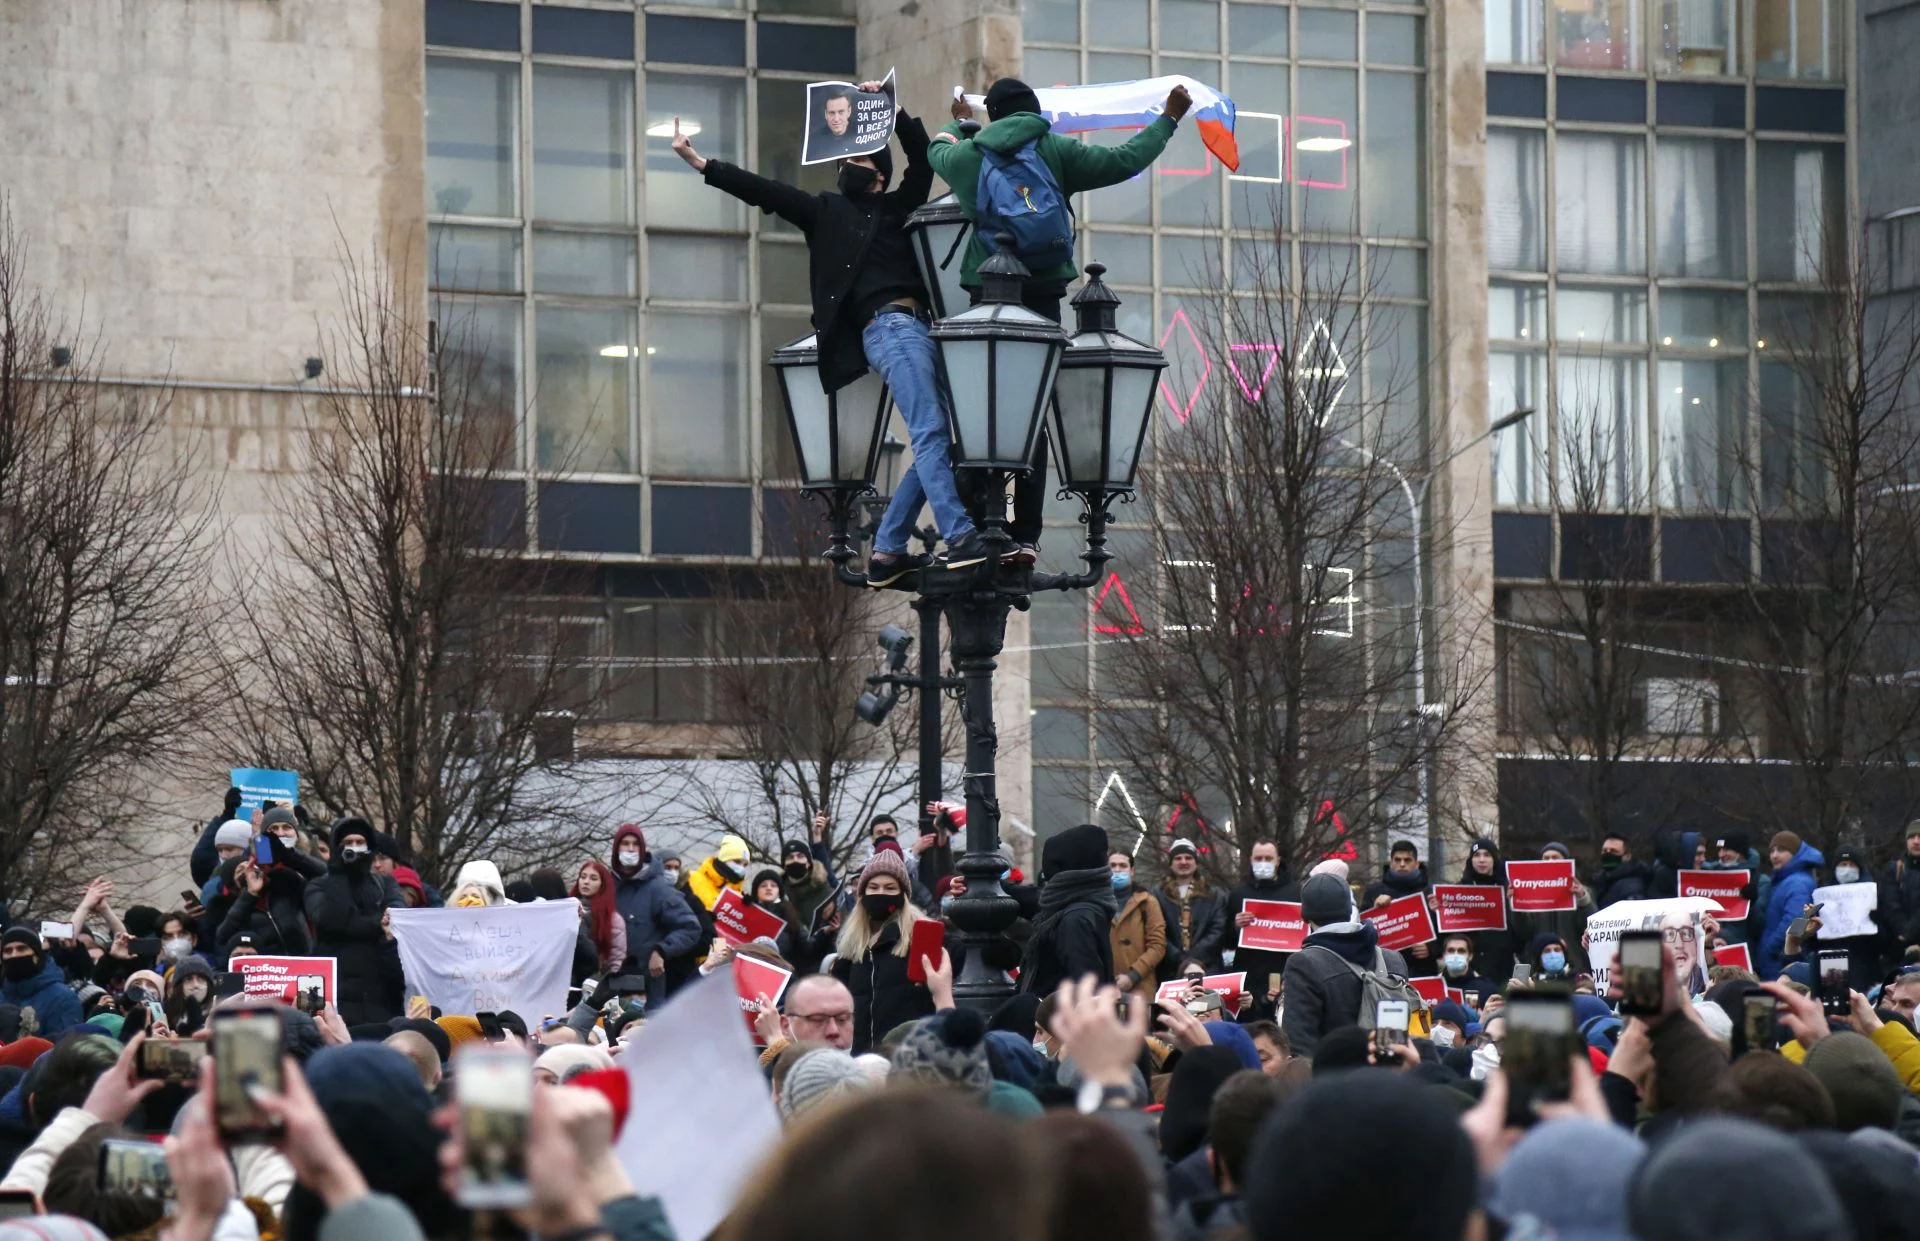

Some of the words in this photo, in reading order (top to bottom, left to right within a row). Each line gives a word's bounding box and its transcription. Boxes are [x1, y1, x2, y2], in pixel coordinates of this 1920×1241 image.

[857, 100, 884, 111] ОДИН
[857, 112, 869, 122] ЗА
[857, 125, 864, 134] И
[866, 121, 883, 133] ВСЕ
[855, 129, 887, 144] ОДНОГО
[1513, 877, 1568, 890] Отпускай!
[1442, 893, 1454, 901] Не
[1455, 893, 1485, 901] боюсь
[720, 902, 732, 912] Я
[730, 908, 744, 920] не
[716, 911, 748, 934] боюсь
[1589, 918, 1632, 929] Кантемир
[242, 964, 288, 974] Свободу
[244, 982, 288, 997] Свободу
